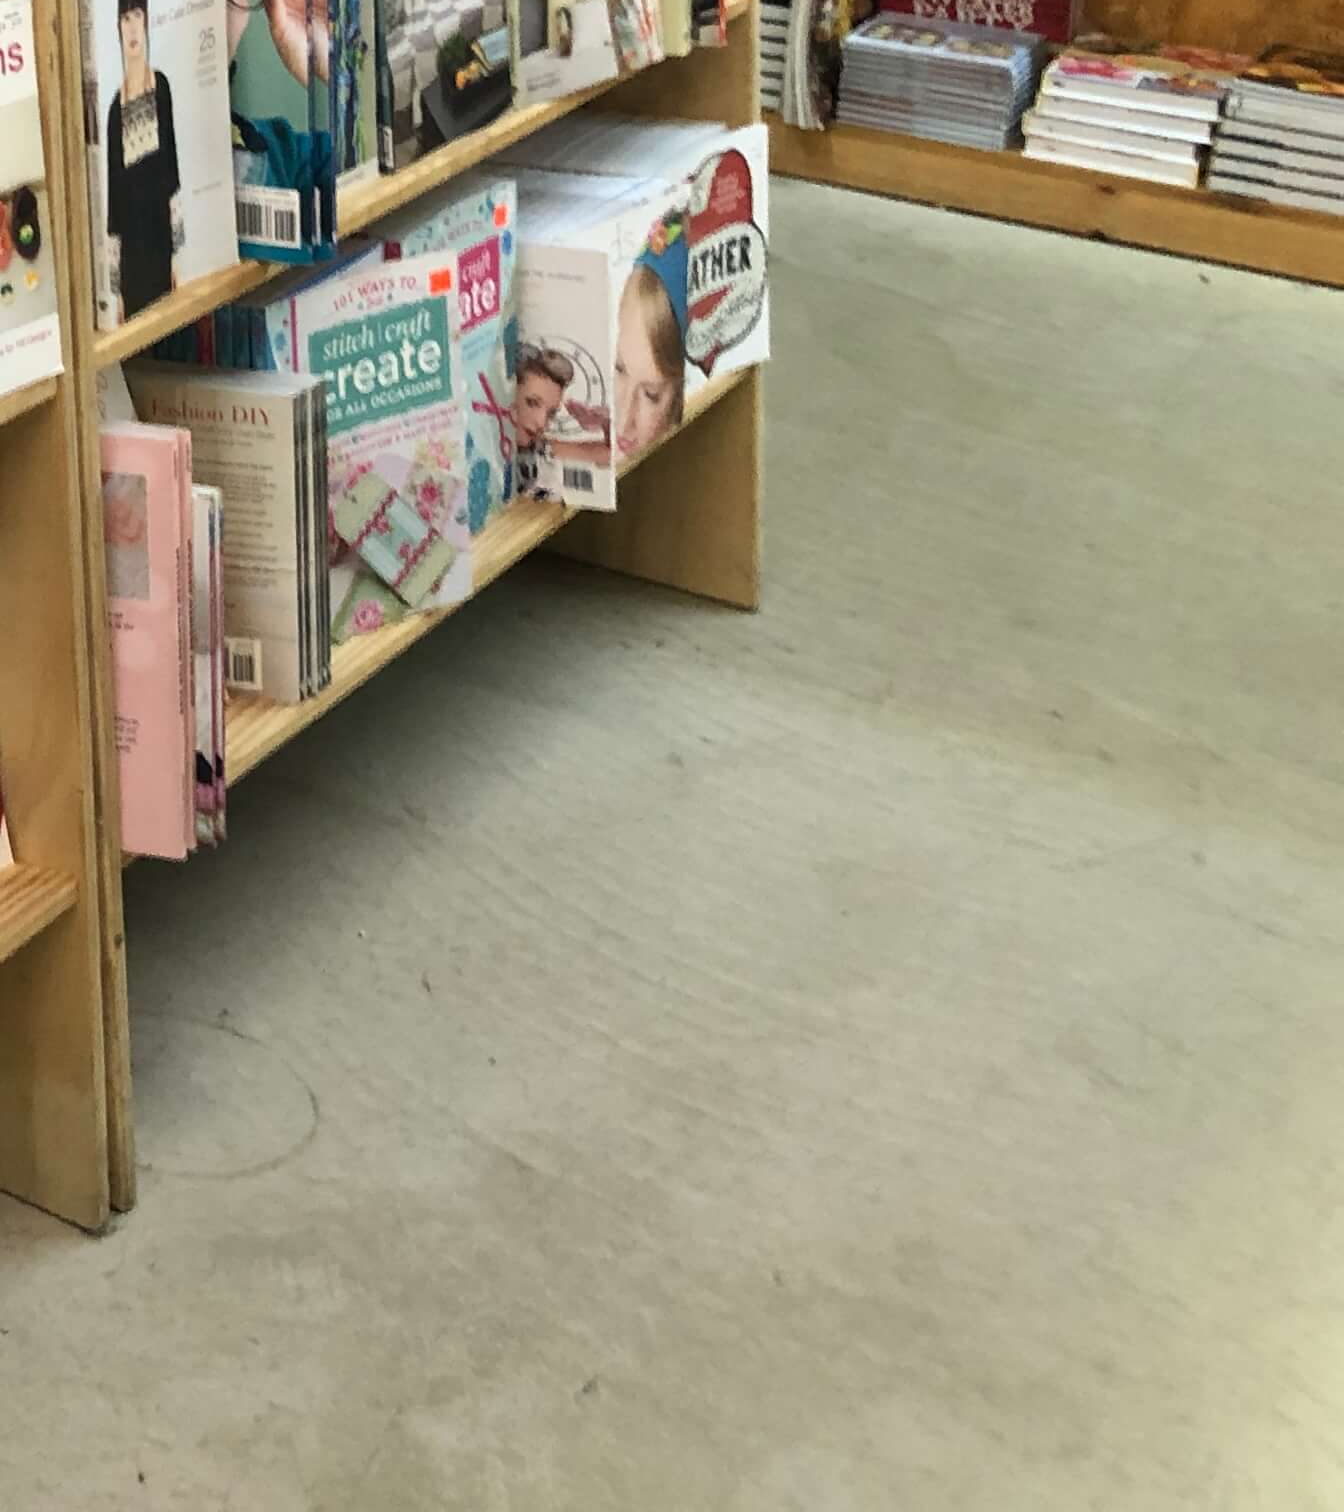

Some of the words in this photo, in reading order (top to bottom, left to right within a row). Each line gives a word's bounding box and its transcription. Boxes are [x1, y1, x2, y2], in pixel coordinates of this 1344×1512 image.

[331, 288, 357, 314] 101
[322, 317, 377, 362] stitch
[382, 310, 433, 352] craft
[150, 397, 226, 428] Fashion
[232, 406, 272, 428] DIY
